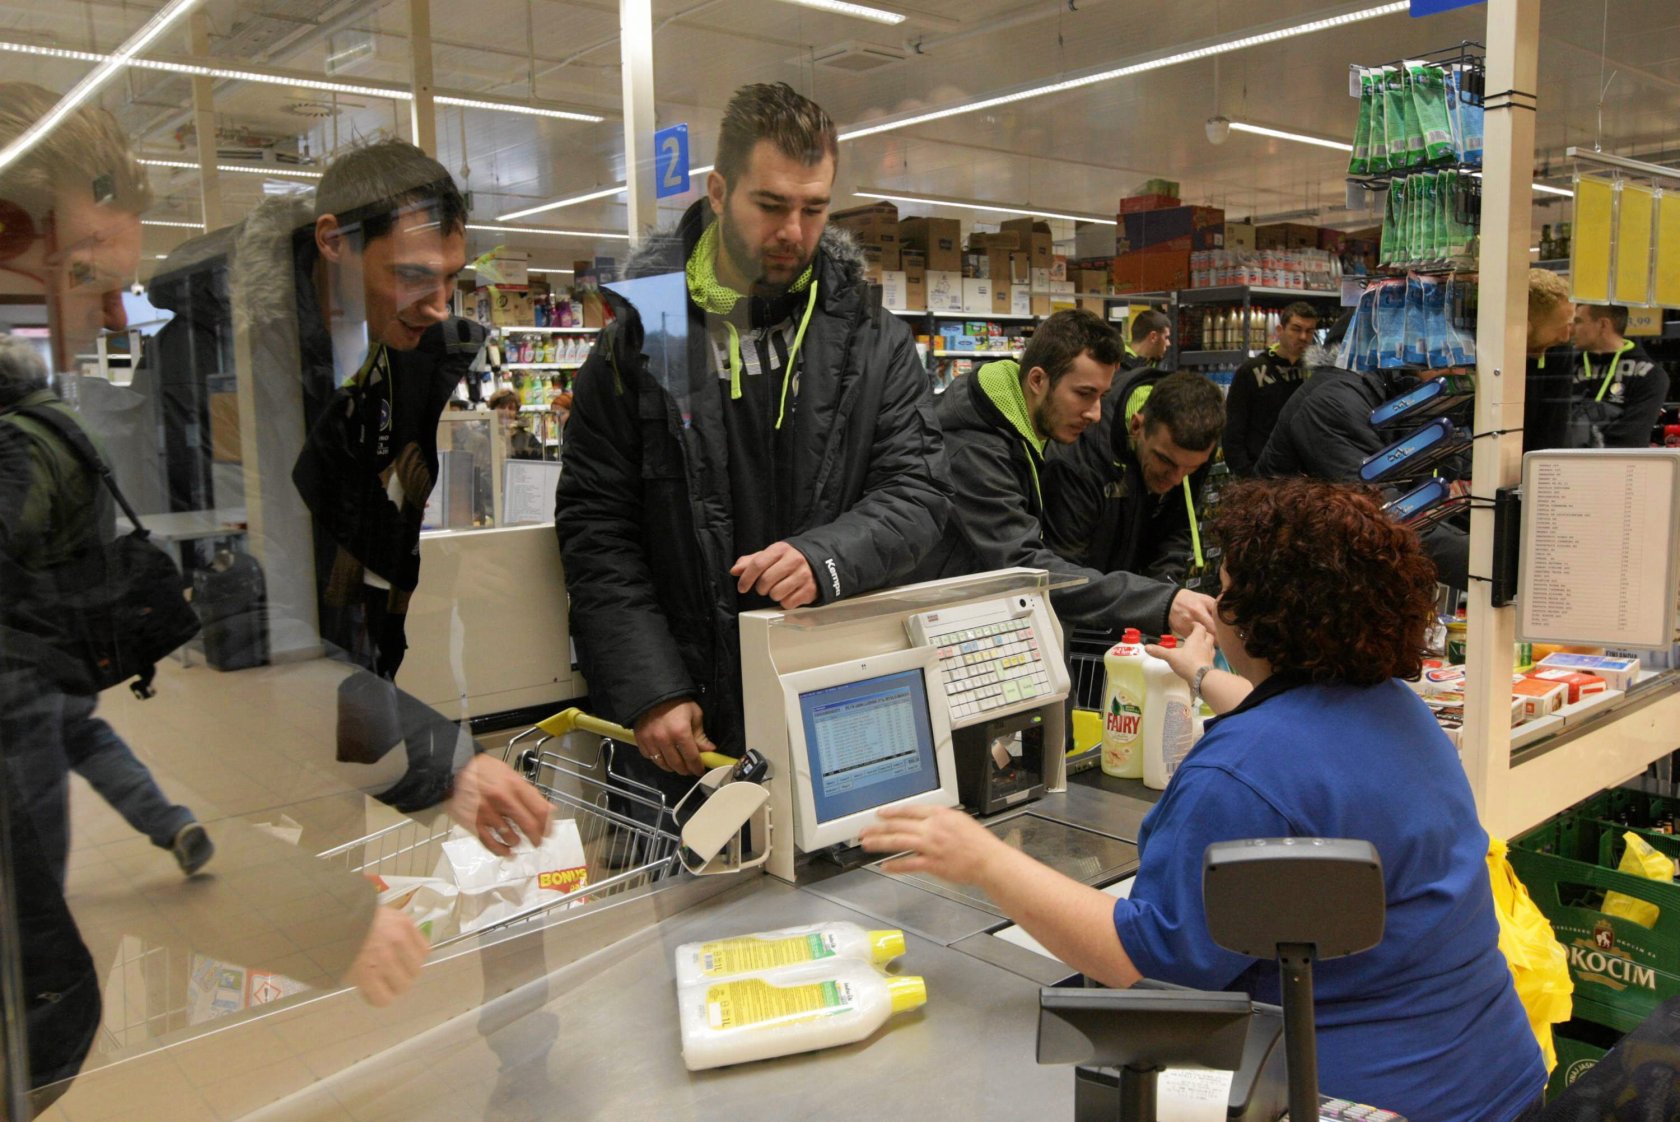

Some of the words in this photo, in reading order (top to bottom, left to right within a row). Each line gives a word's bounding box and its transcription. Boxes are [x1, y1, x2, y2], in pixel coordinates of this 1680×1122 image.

[662, 137, 681, 188] 2
[825, 558, 841, 597] Kempa
[1107, 712, 1142, 735] FAIRY
[540, 868, 587, 887] BONUS
